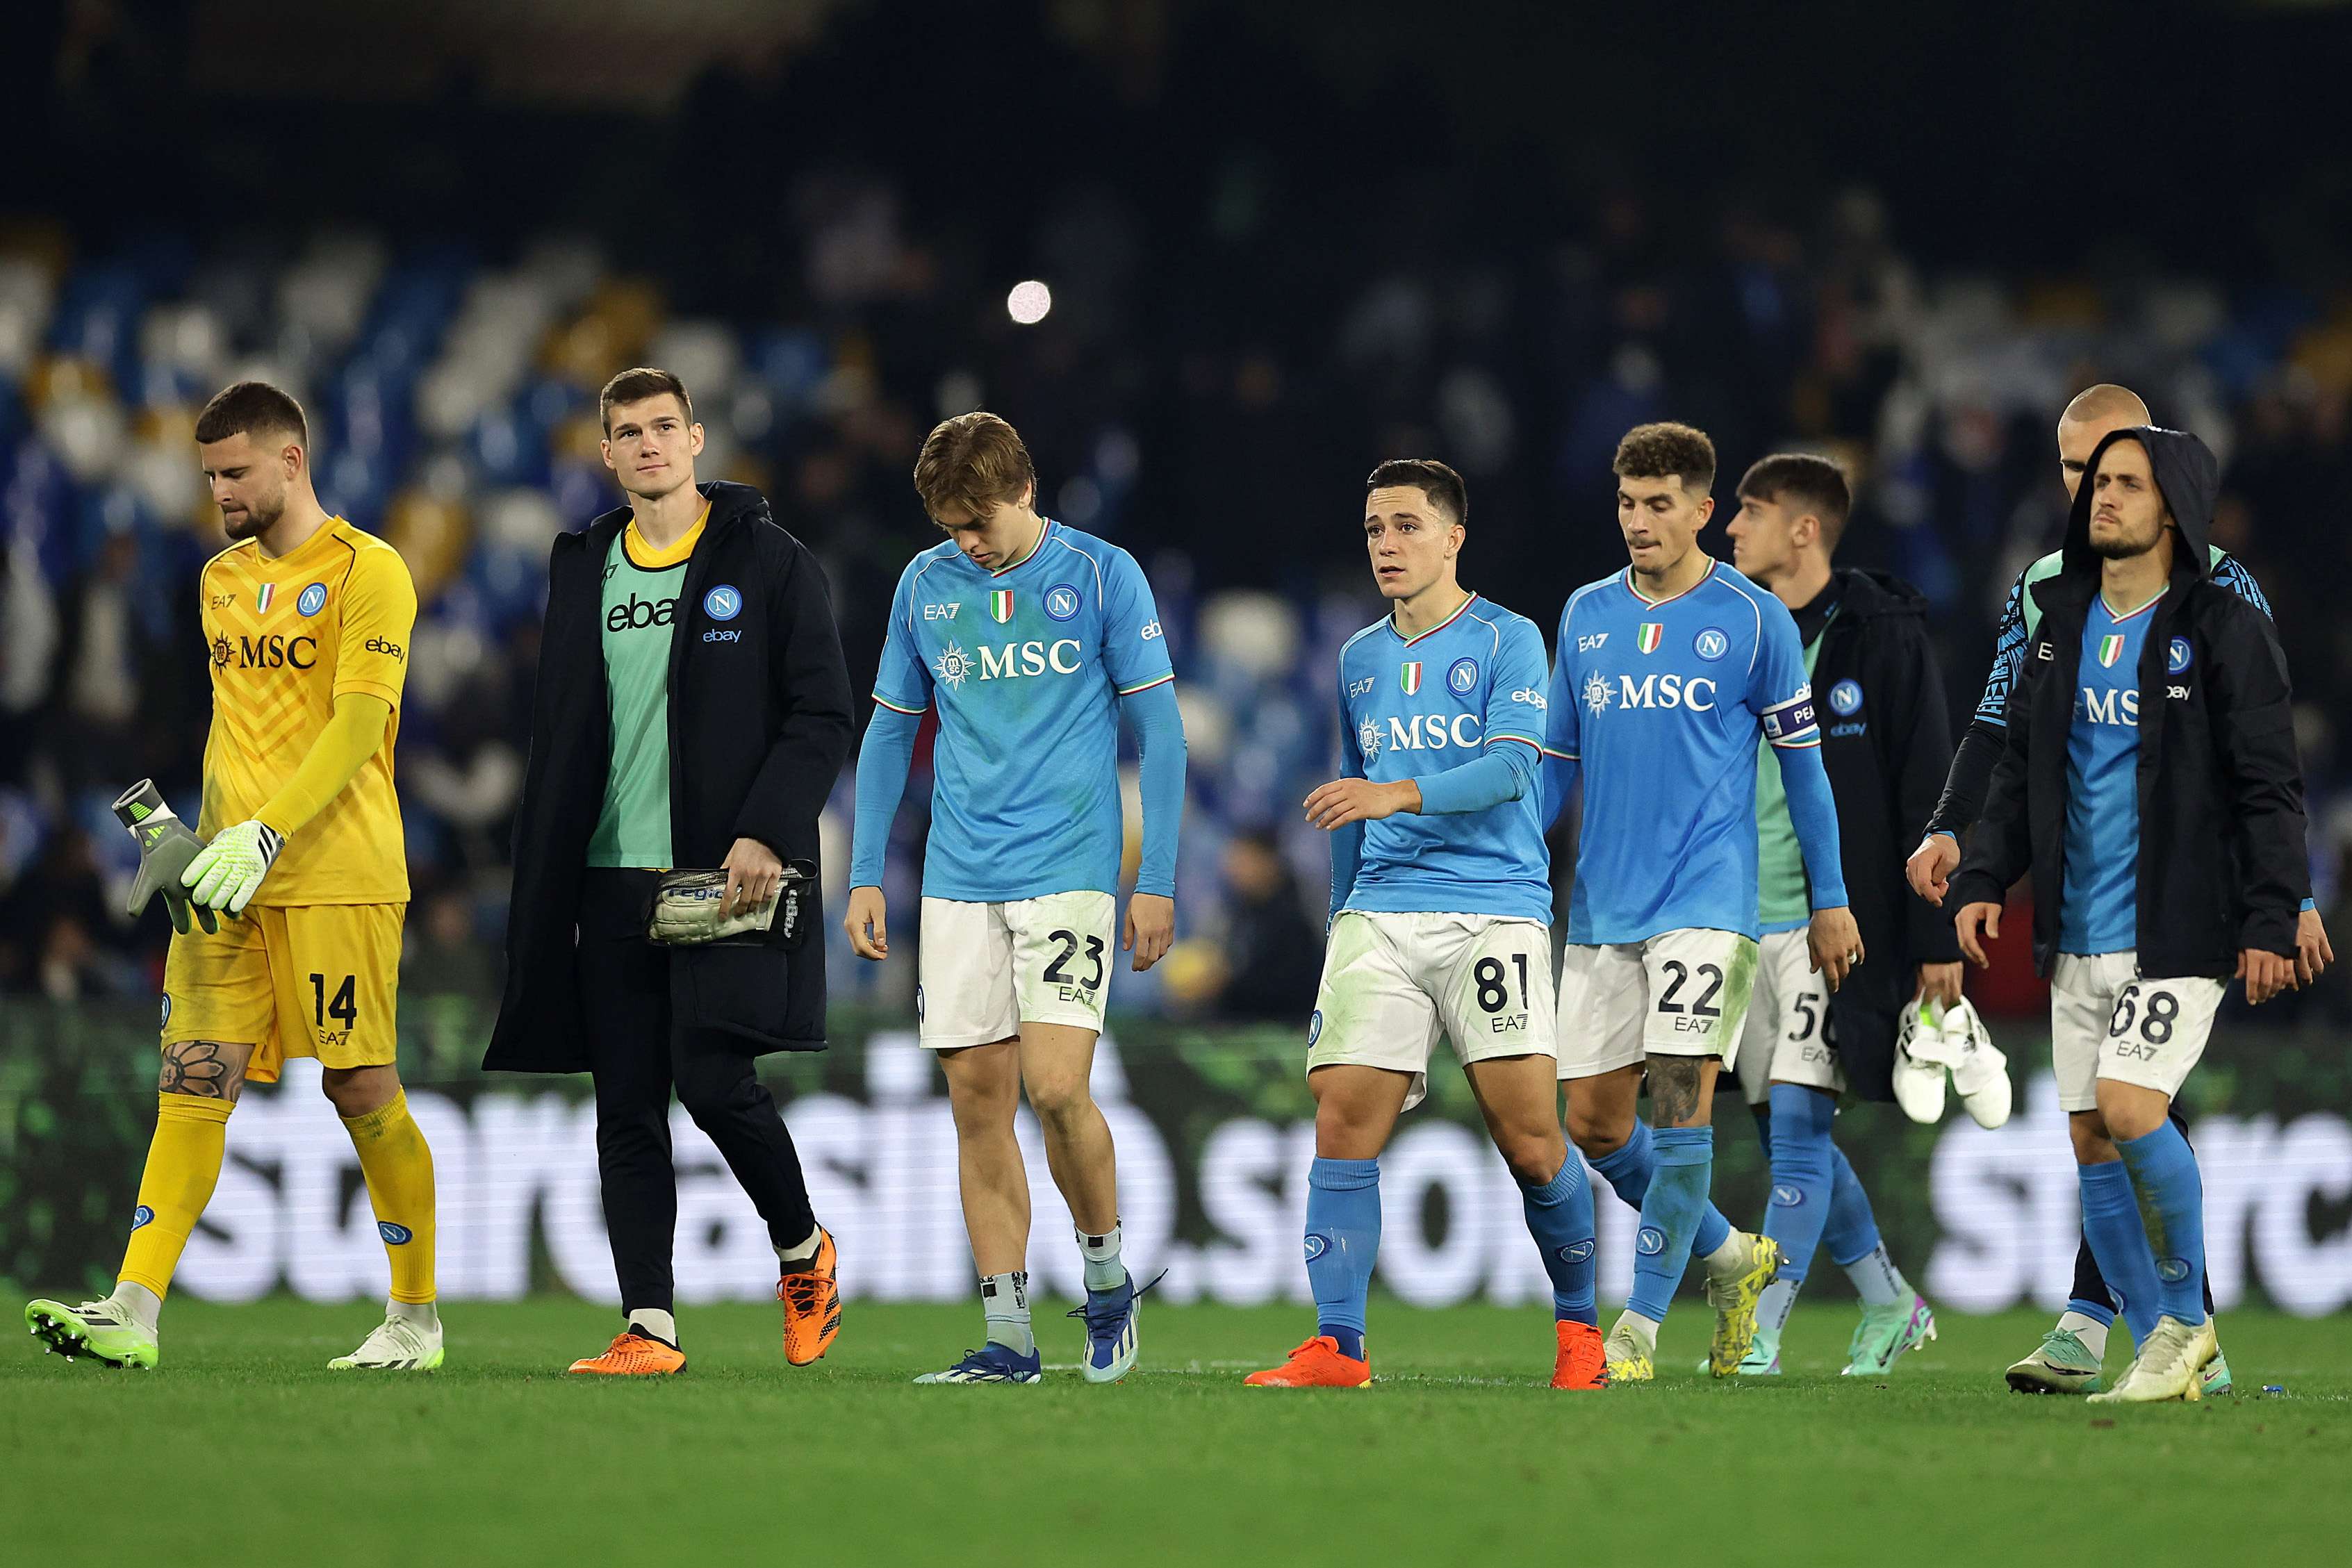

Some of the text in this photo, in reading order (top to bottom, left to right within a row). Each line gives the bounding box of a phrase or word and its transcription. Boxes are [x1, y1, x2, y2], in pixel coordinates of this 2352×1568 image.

[211, 594, 236, 609] EA7
[923, 602, 961, 620] EA7
[702, 628, 742, 643] ebay
[1578, 633, 1609, 653] EA7
[239, 635, 317, 669] MSC
[365, 636, 406, 664] ebay
[978, 639, 1082, 681] MSC
[1349, 677, 1375, 698] EA7
[1618, 674, 1717, 712] MSC
[1388, 712, 1482, 751] MSC
[1830, 722, 1868, 737] ebay
[1043, 930, 1104, 990] 23
[1474, 953, 1529, 1013] 81
[1659, 960, 1723, 1017] 22
[310, 973, 356, 1030] 14
[1058, 986, 1096, 1005] EA7
[1491, 1014, 1529, 1033] EA7
[1675, 1016, 1714, 1034] EA7
[2110, 986, 2179, 1044] 68
[319, 1029, 350, 1046] EA7
[2116, 1041, 2158, 1061] EA7
